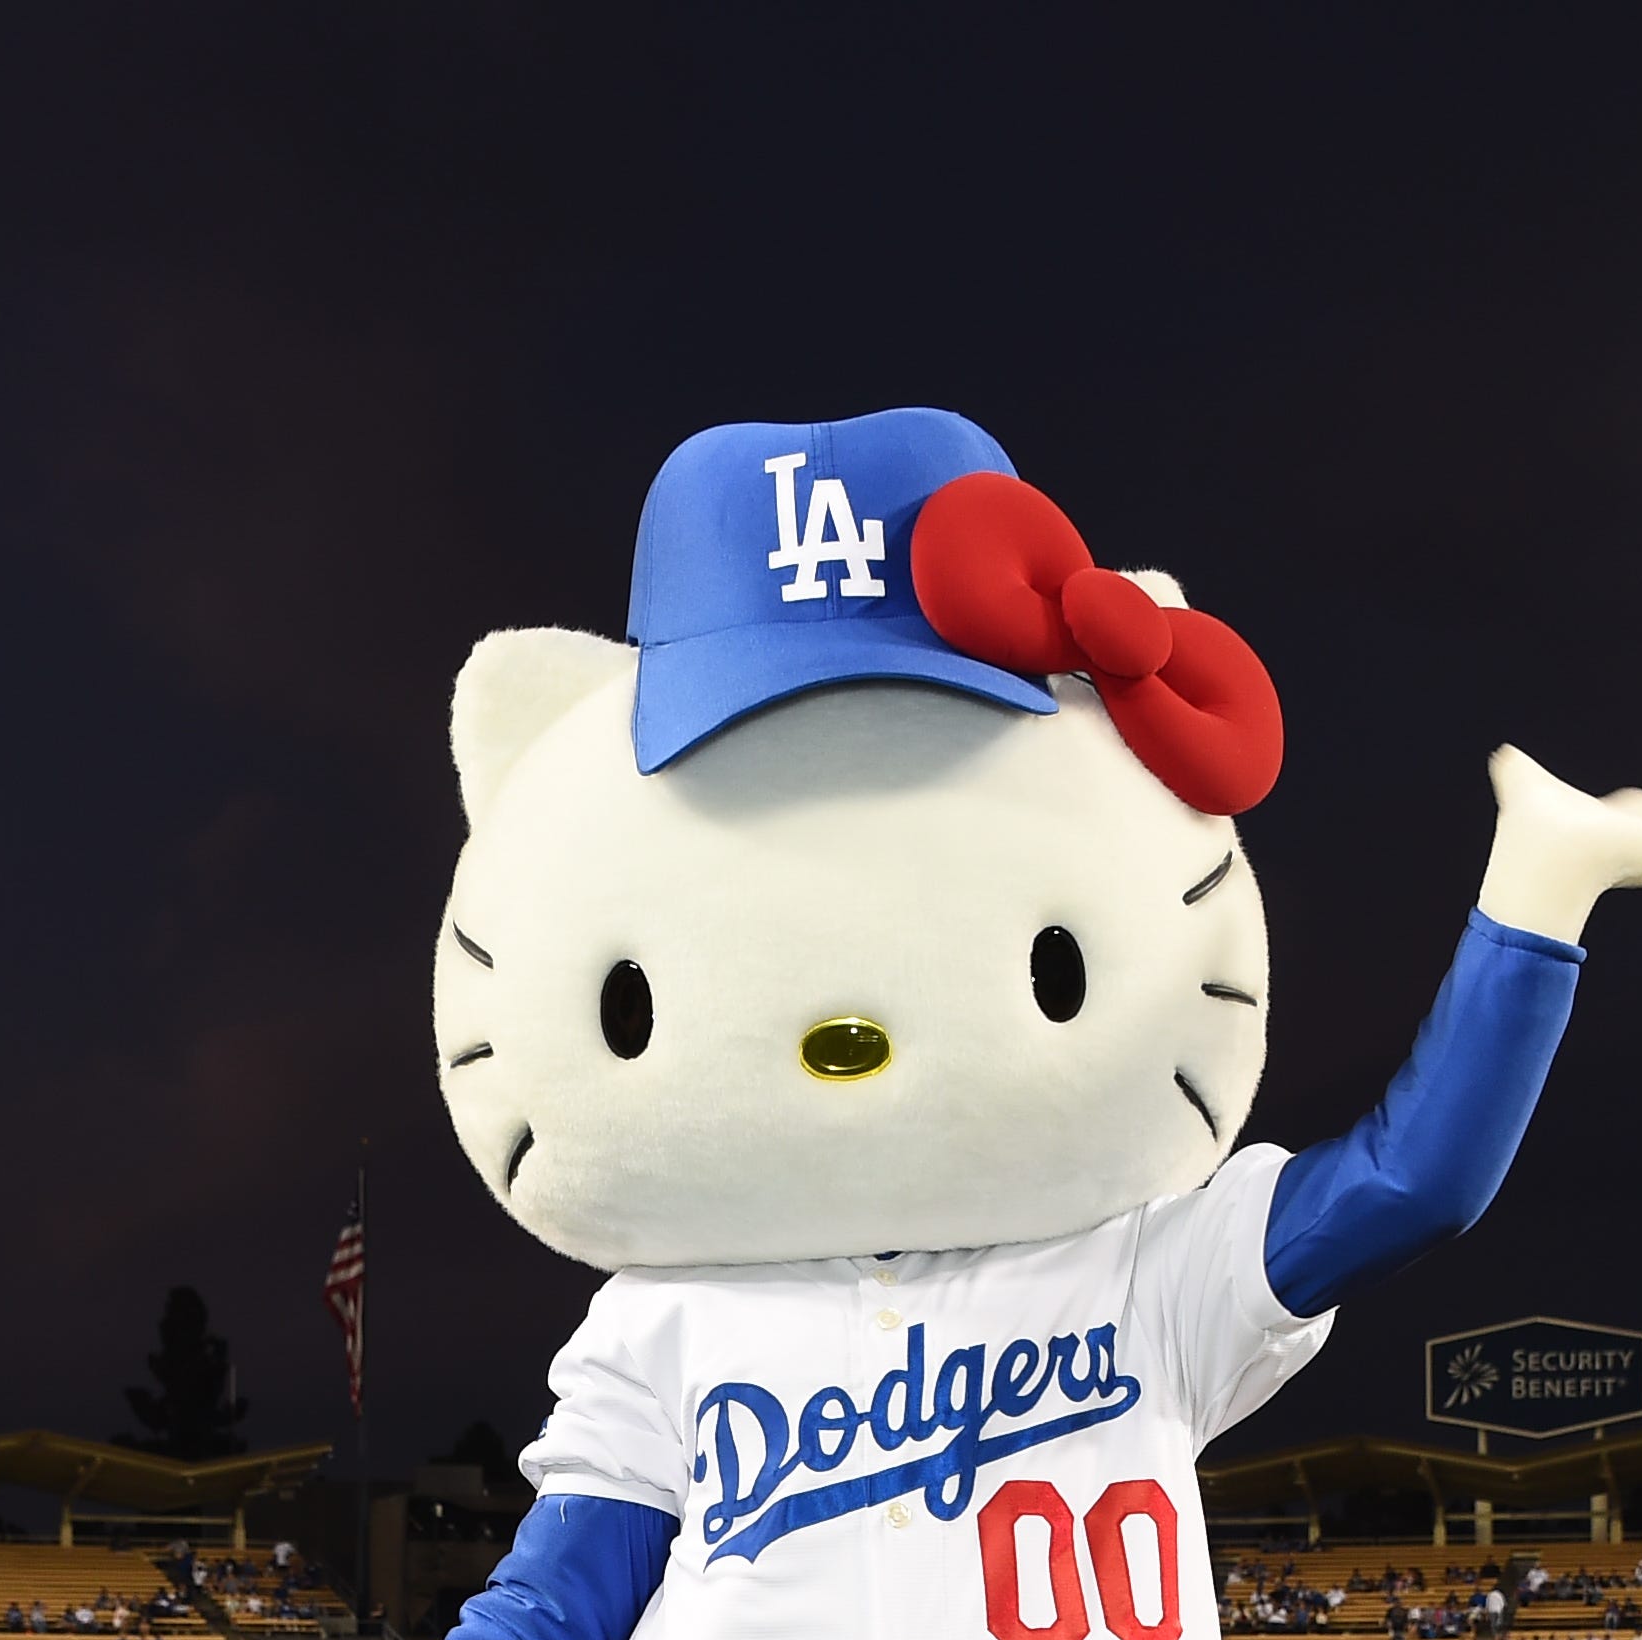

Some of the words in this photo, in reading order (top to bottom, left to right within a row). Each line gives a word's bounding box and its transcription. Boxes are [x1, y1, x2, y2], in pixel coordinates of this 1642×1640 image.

[764, 452, 886, 602] LA
[1512, 1349, 1634, 1372] SECURITY
[693, 1322, 1141, 1573] Dodgers
